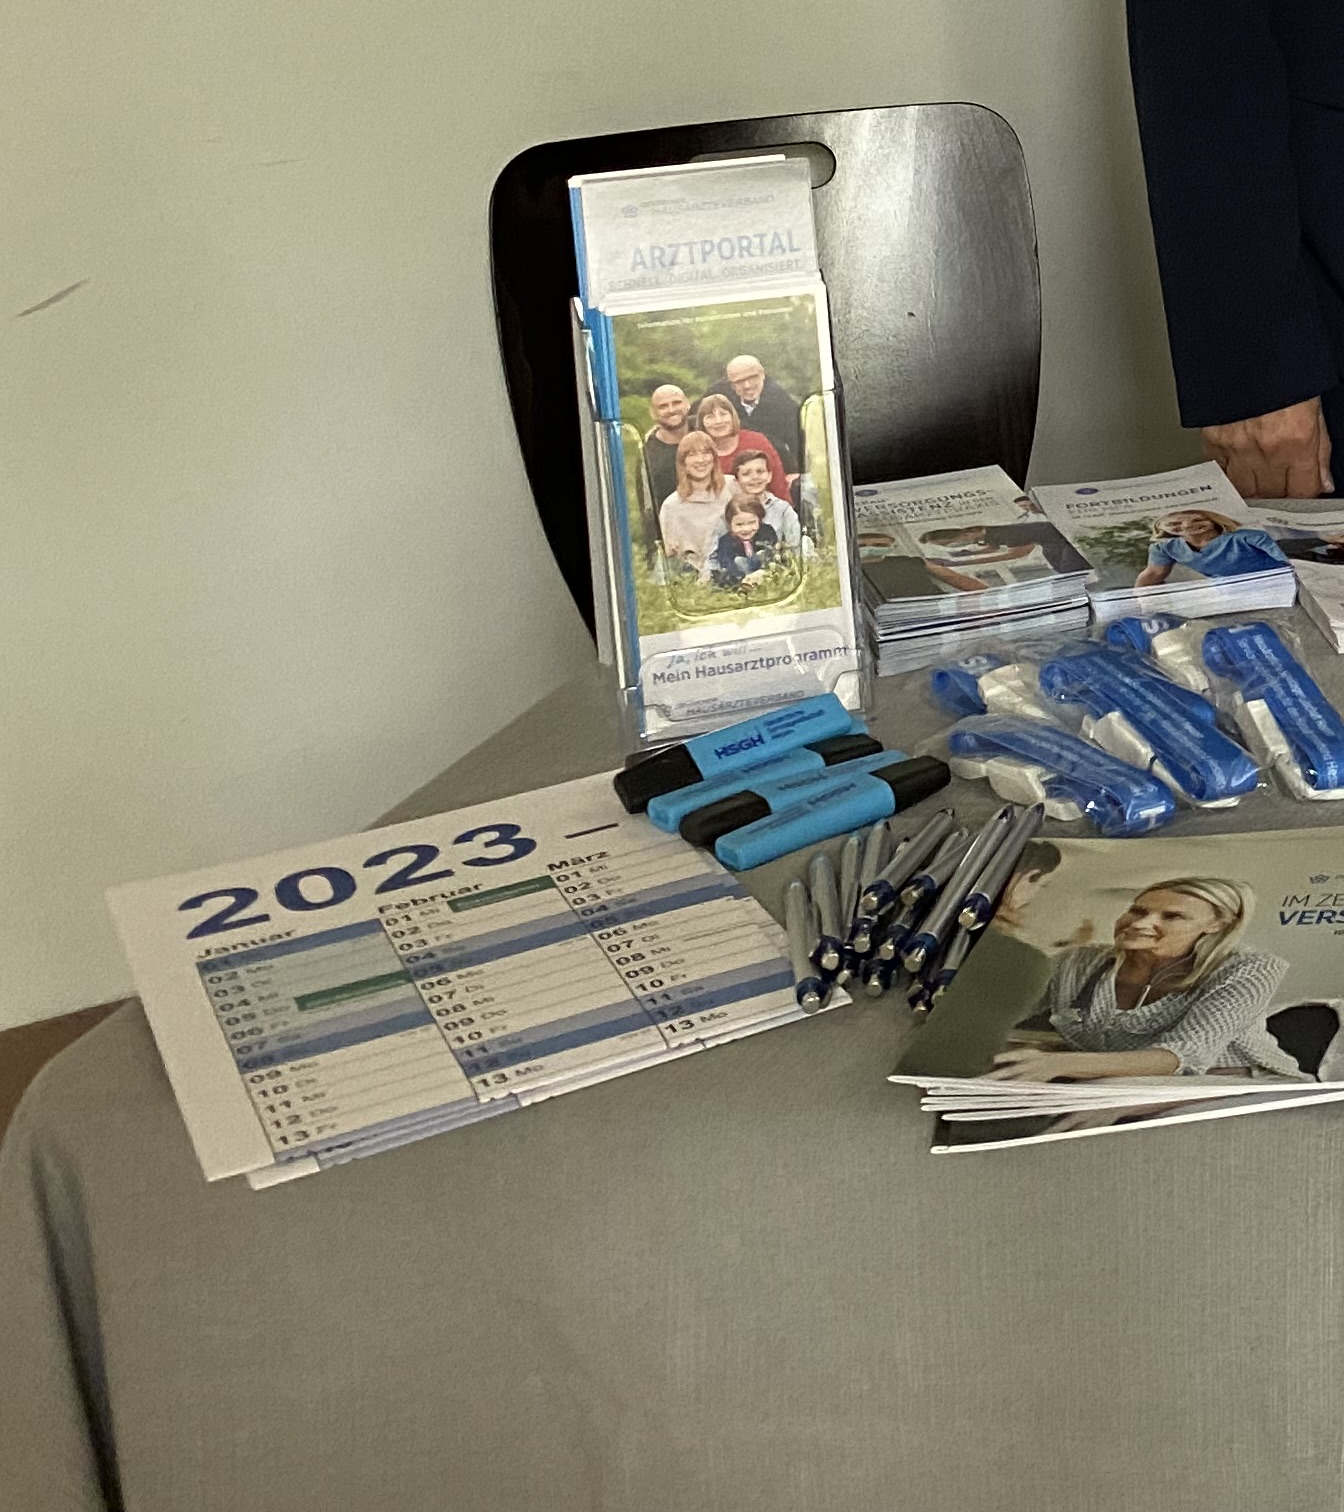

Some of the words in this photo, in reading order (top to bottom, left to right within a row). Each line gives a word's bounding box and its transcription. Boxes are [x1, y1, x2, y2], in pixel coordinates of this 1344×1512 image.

[629, 229, 802, 273] ARZTPORTAL
[1065, 484, 1213, 510] FORTBILDUNGEN
[652, 670, 691, 686] Mein
[546, 850, 611, 872] März
[177, 822, 538, 940] 2023
[377, 883, 484, 914] Februar
[1282, 893, 1311, 908] IM
[197, 928, 298, 959] Januar
[665, 1019, 696, 1034] 13
